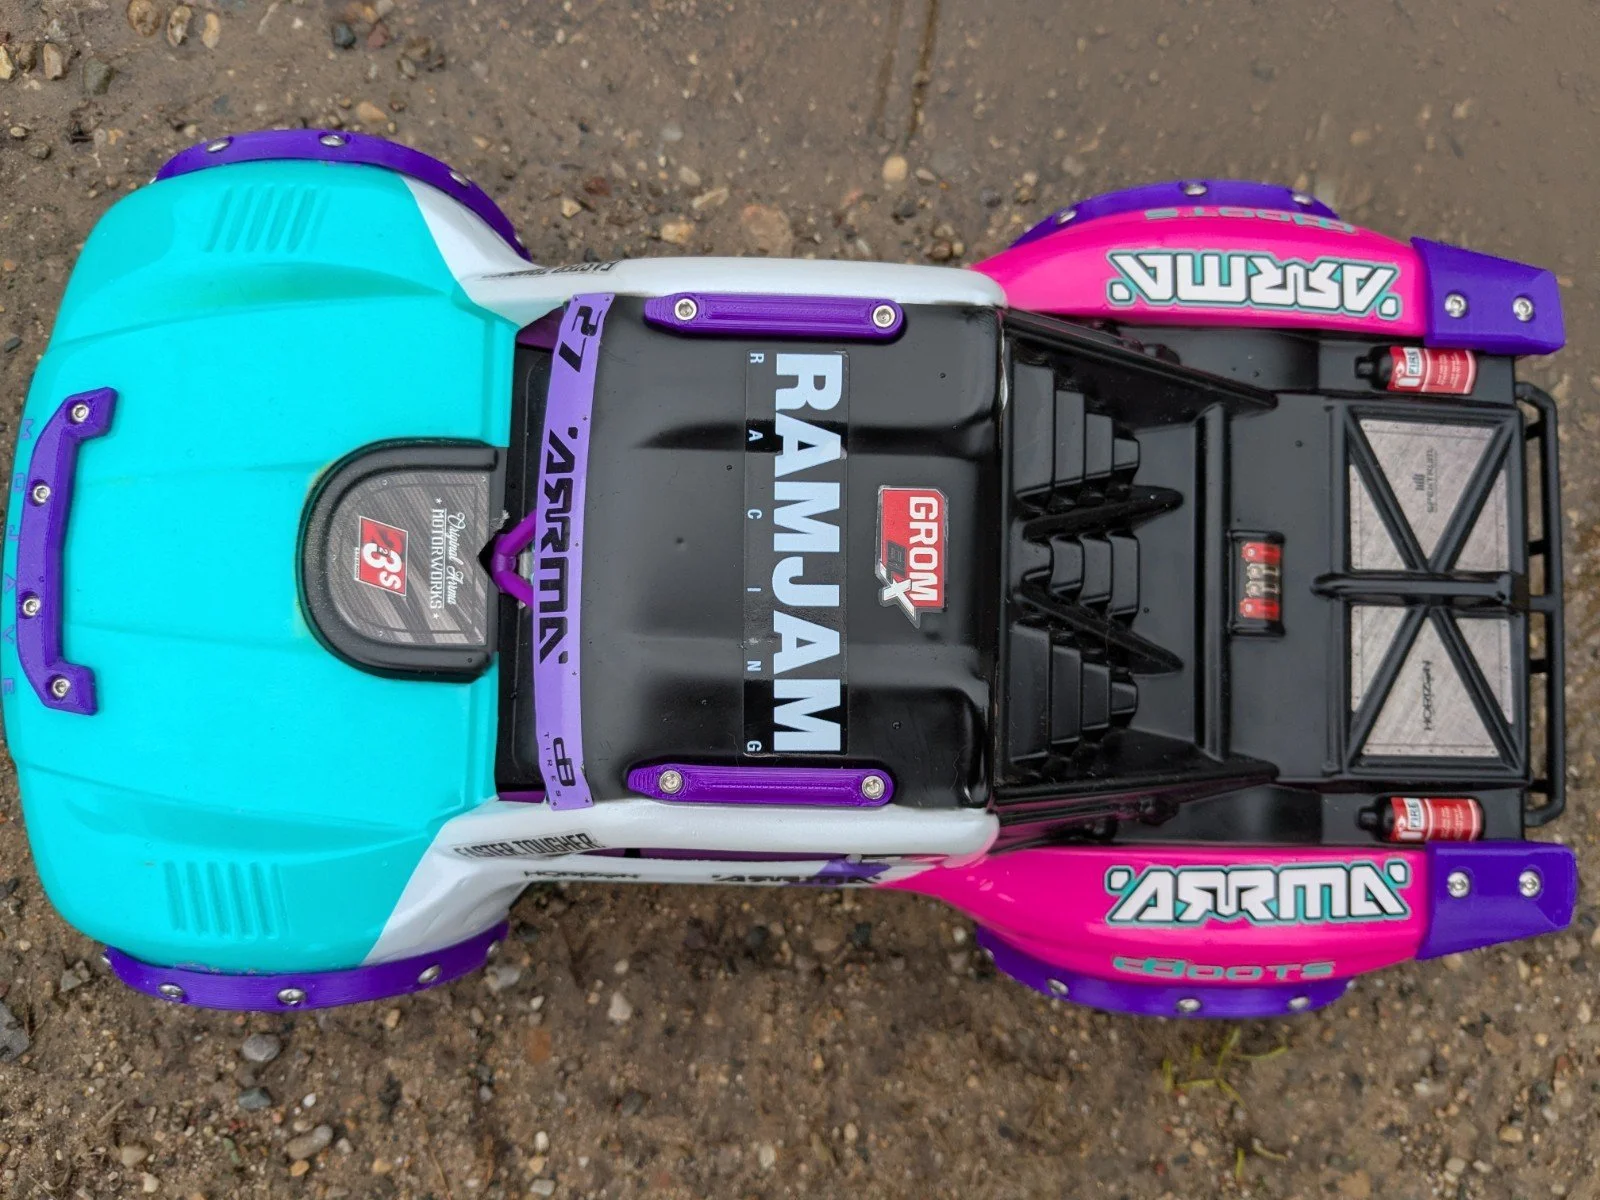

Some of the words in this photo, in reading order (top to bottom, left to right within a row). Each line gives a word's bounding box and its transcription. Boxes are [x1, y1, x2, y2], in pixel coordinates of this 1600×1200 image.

[1108, 252, 1400, 317] ARRMA
[559, 306, 603, 373] 27
[430, 508, 444, 609] MOTORWORKS
[447, 512, 466, 565] Original
[540, 427, 578, 664] ARRMA
[747, 353, 764, 752] RACING
[772, 353, 842, 751] RAMJAM
[909, 496, 939, 601] GROM
[446, 566, 464, 605] Arrma
[879, 543, 916, 621] BLX
[544, 732, 561, 796] TIRES
[1408, 803, 1420, 828] FIRE
[1107, 862, 1408, 925] ARRMA
